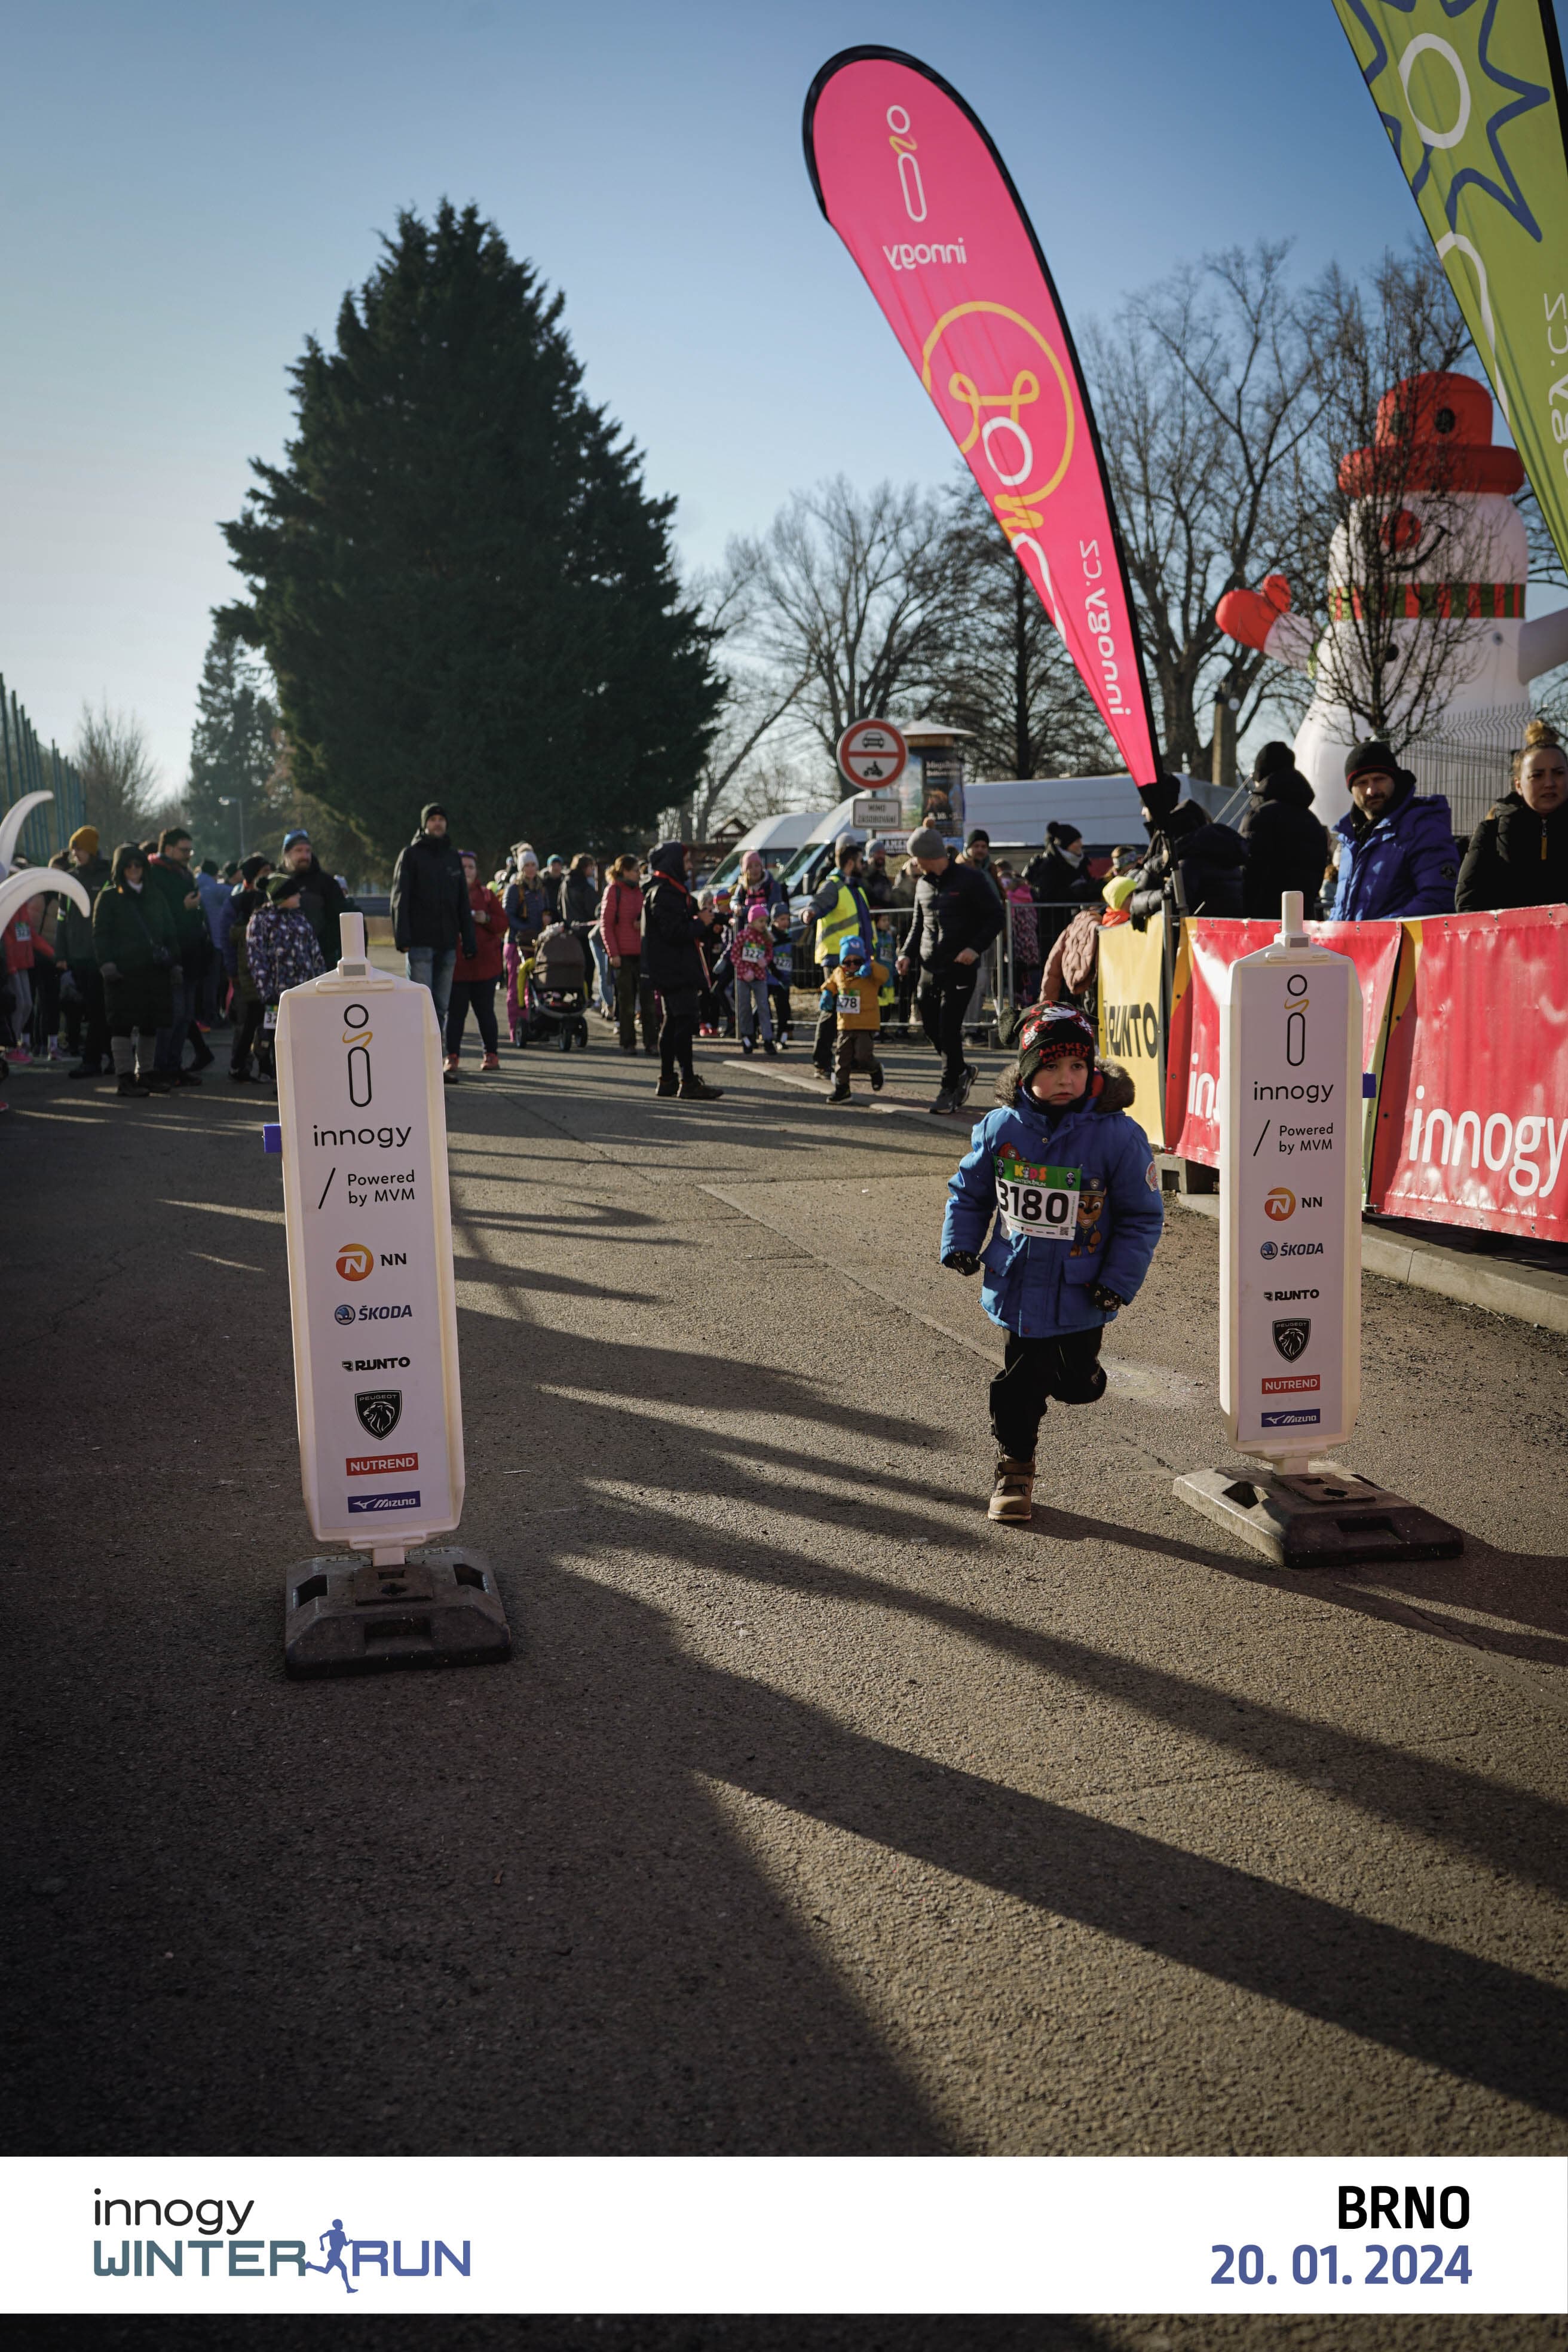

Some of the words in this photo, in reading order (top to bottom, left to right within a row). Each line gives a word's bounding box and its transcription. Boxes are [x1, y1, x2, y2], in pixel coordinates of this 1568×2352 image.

[1254, 1081, 1334, 1103] innogy
[314, 1125, 412, 1148] innogy
[1279, 1122, 1334, 1137] Powered
[1279, 1140, 1295, 1155] by
[1300, 1138, 1333, 1152] MVM
[1408, 1085, 1568, 1198] innogy
[347, 1169, 415, 1186] Powered
[348, 1190, 367, 1207] by
[375, 1187, 415, 1203] MVM
[998, 1180, 1069, 1224] 3180
[1301, 1196, 1323, 1208] NN
[1280, 1242, 1324, 1256] ŠKODA
[380, 1252, 407, 1267] NN
[1275, 1288, 1319, 1301] RUNTO
[358, 1304, 413, 1321] ŠKODA
[355, 1356, 411, 1371] RUNTO
[1265, 1378, 1318, 1391] NUTREND
[350, 1457, 415, 1472] NUTREND
